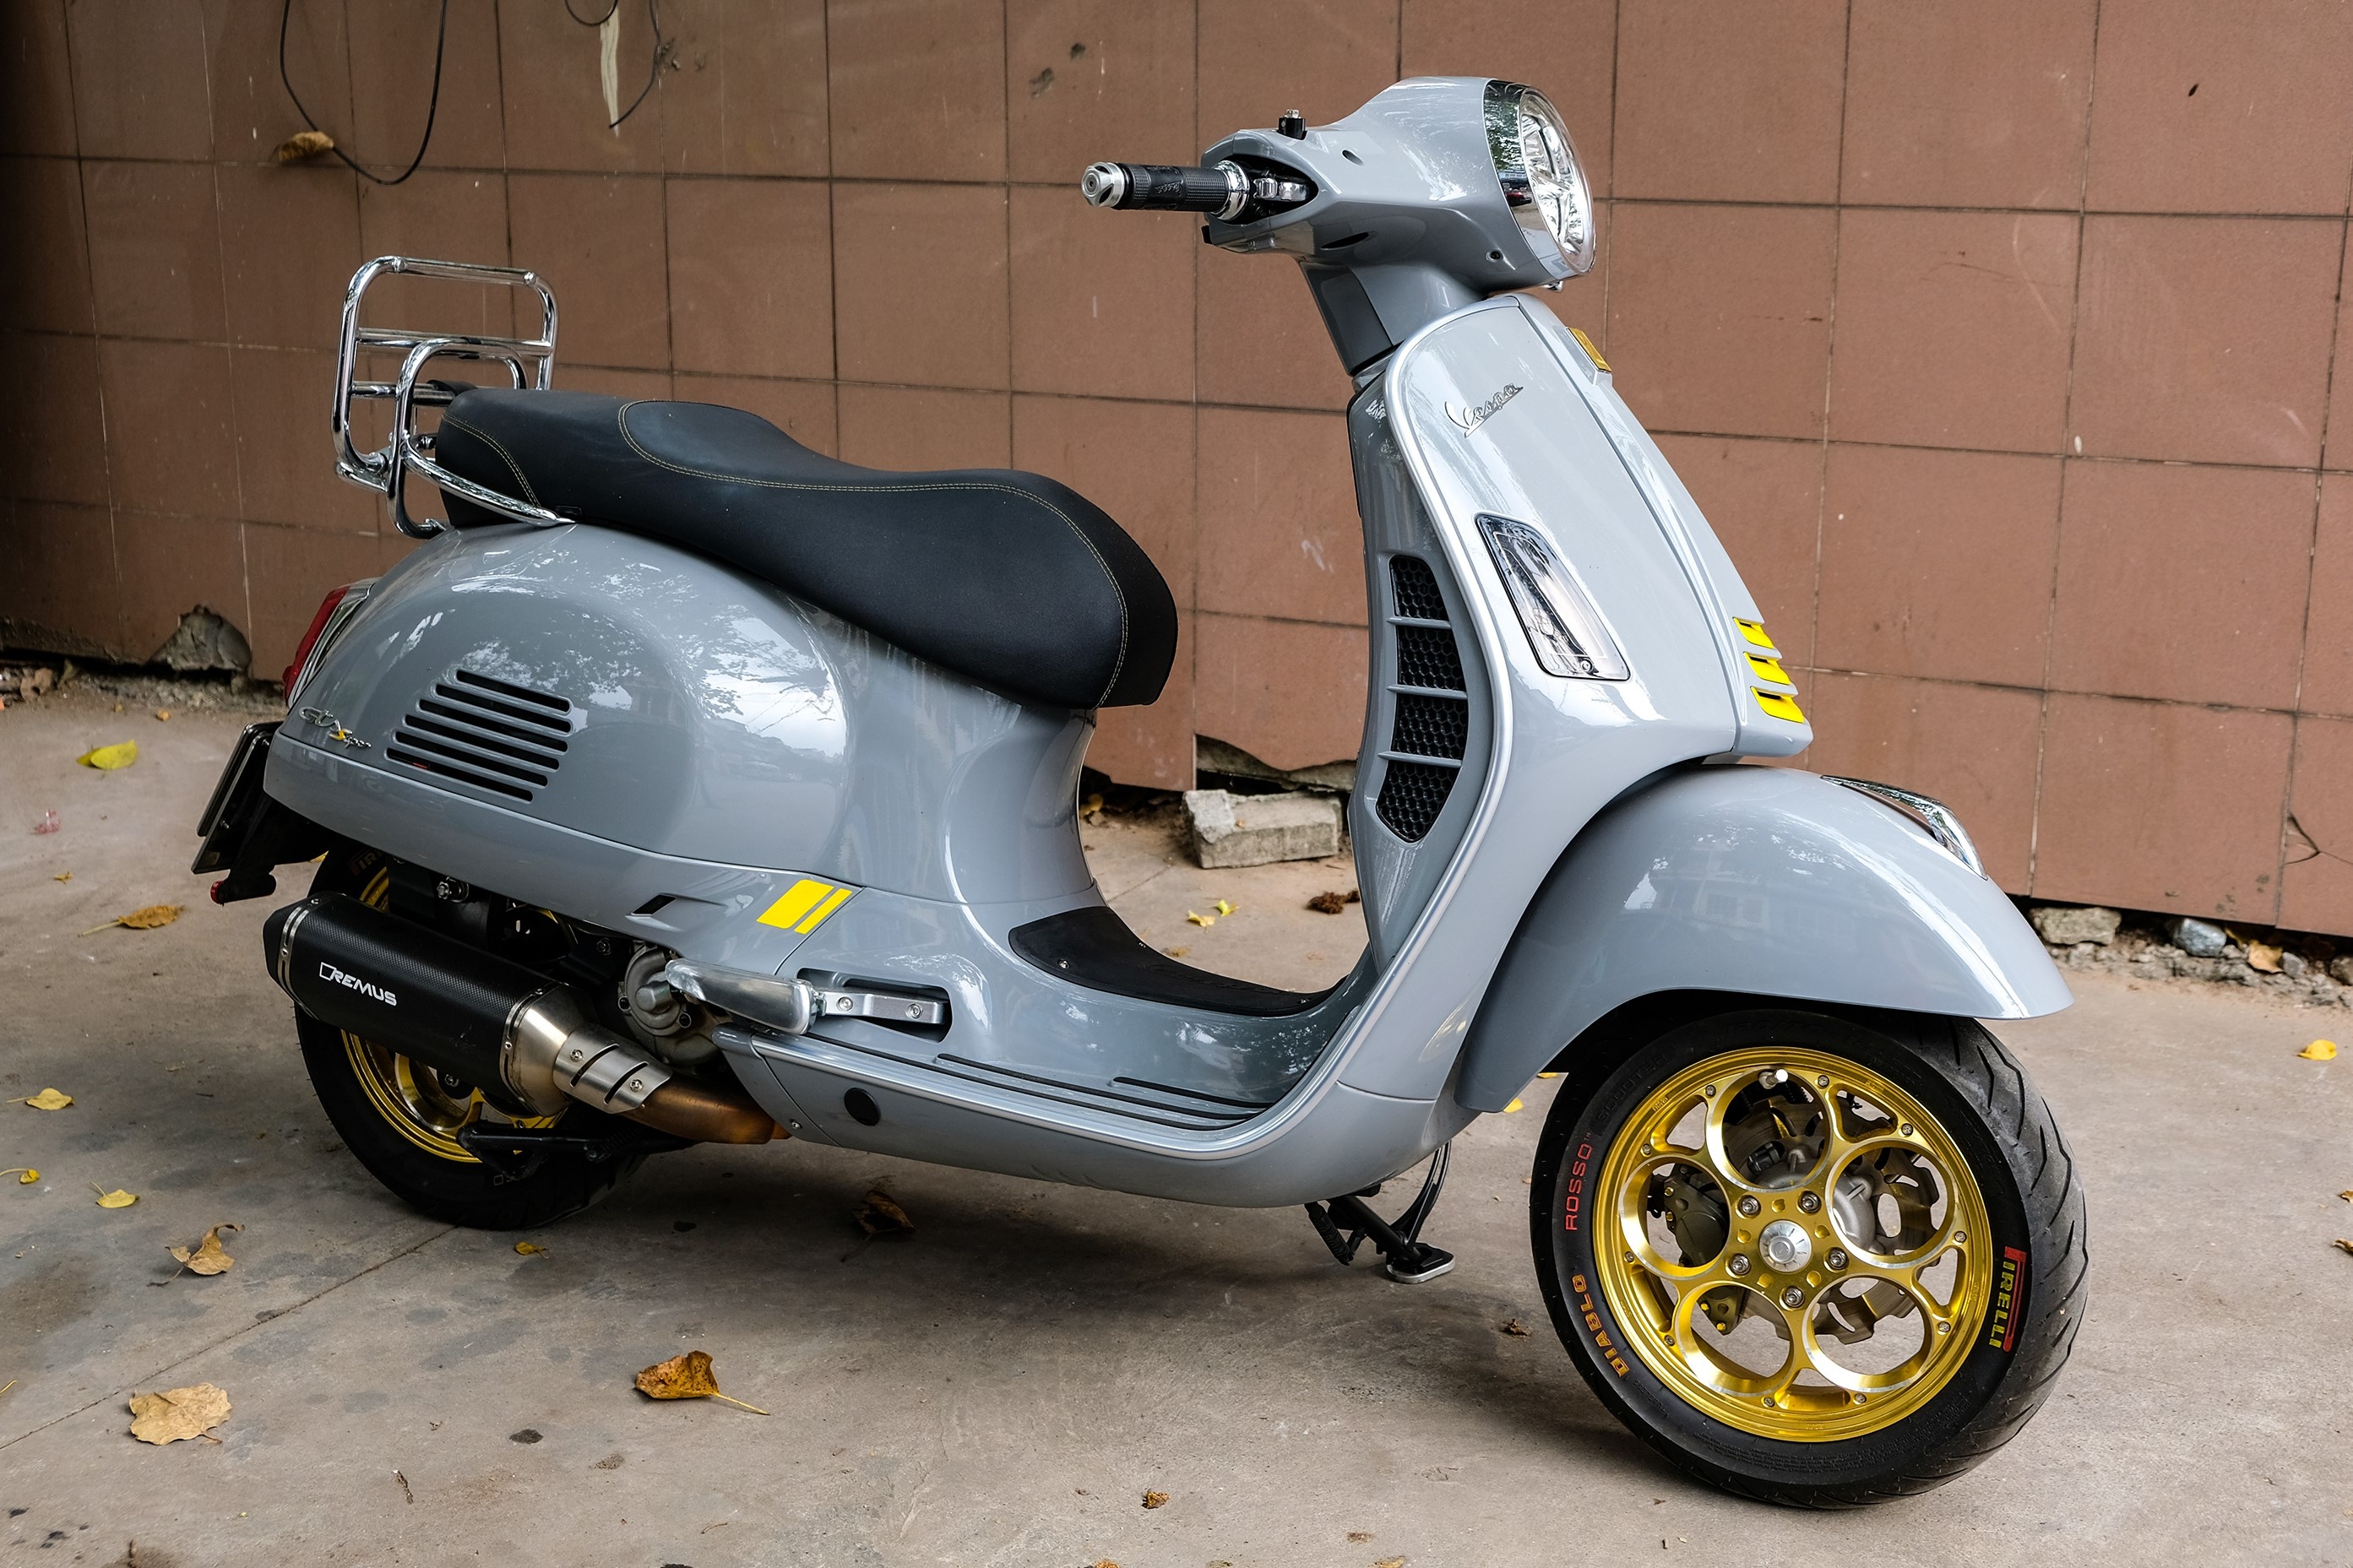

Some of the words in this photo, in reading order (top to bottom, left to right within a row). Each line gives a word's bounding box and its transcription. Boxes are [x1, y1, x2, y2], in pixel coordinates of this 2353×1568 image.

[1444, 383, 1524, 438] Vespa
[329, 968, 397, 1006] REMUS
[1565, 1143, 1593, 1230] ROSSO
[1572, 1274, 1630, 1377] DIABLO
[1989, 1246, 2026, 1352] PIRELLI
